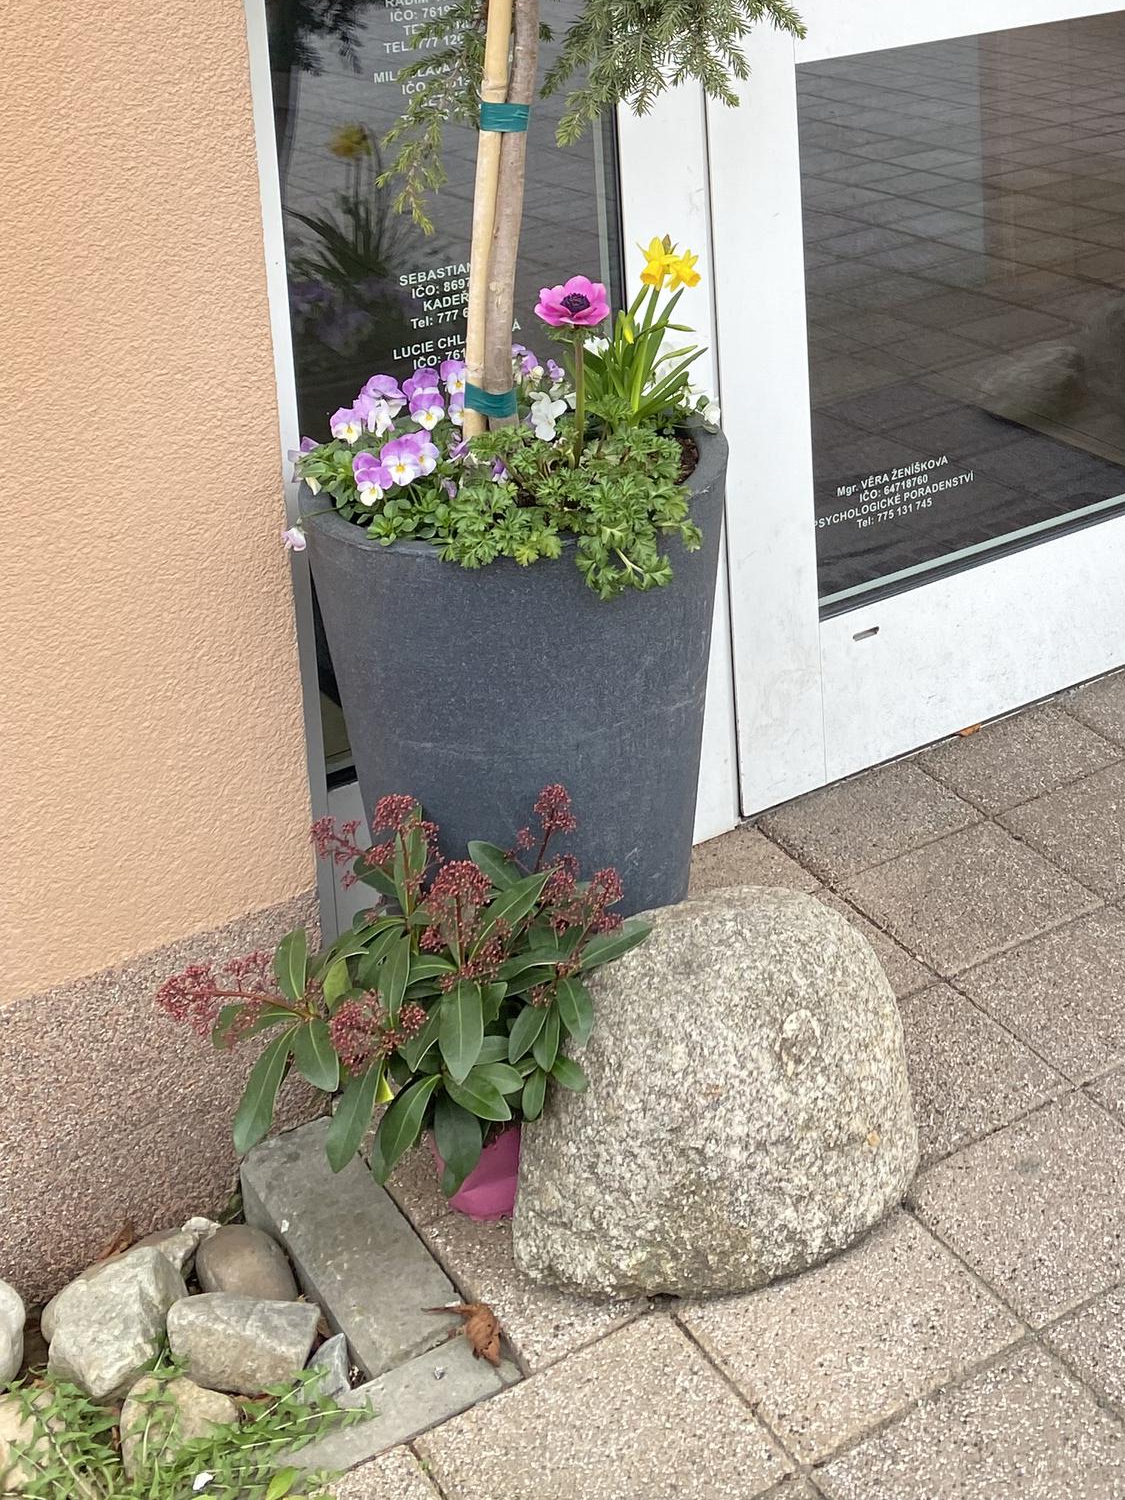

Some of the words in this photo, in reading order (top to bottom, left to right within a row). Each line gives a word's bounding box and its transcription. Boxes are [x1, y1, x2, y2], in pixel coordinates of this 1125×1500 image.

[390, 8, 417, 22] IČO:
[412, 285, 439, 299] IČO:
[410, 316, 433, 329] Tel:
[437, 310, 459, 324] 777
[393, 341, 434, 360] LUCIE
[837, 484, 859, 497] Mgr.
[861, 473, 889, 489] VĚRA
[859, 489, 882, 503] IČO:
[884, 474, 928, 496] 64718760
[904, 470, 974, 501] PORADENSTVÍ
[857, 517, 874, 529] Tel:
[877, 512, 894, 523] 775
[897, 504, 913, 516] 131
[916, 498, 932, 510] 745
